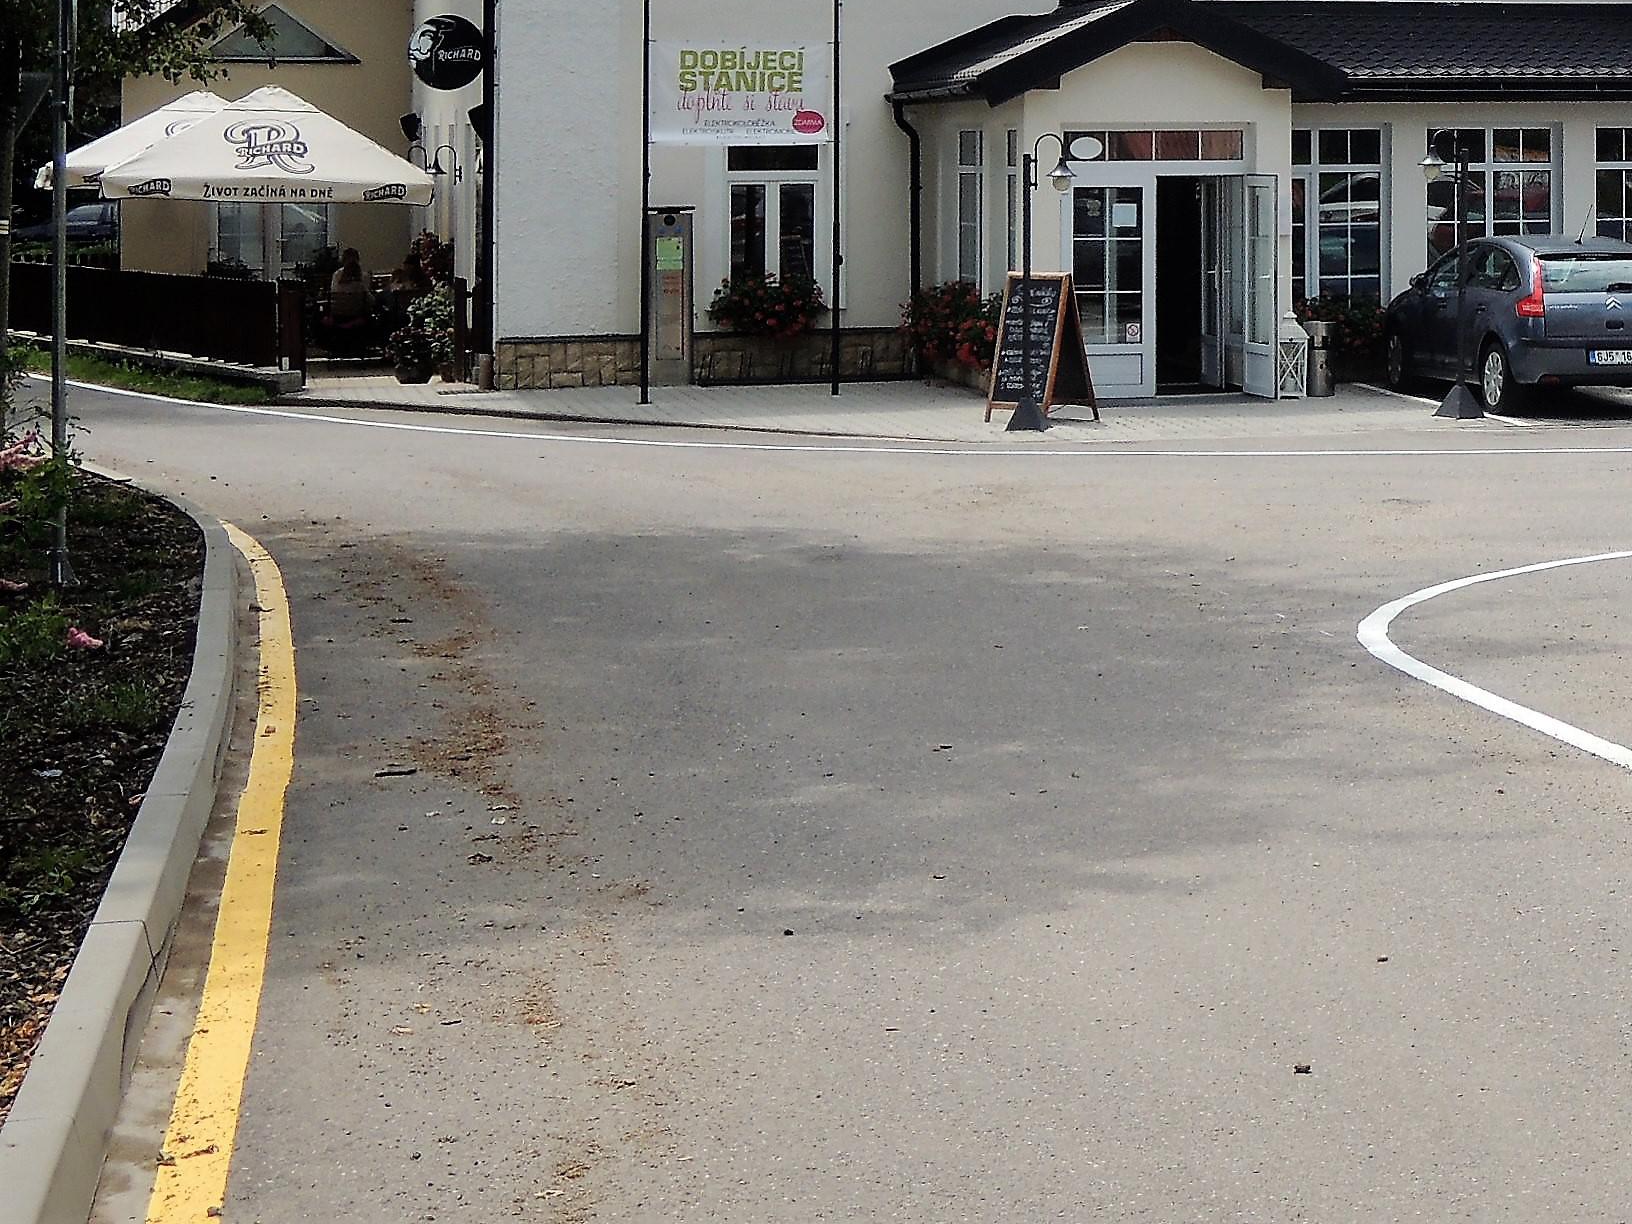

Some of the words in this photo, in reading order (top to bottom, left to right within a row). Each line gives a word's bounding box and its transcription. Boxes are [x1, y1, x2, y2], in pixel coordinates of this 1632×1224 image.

[438, 49, 481, 62] RICHARD
[679, 46, 805, 71] DOBÍJECÍ
[679, 71, 803, 92] STANICE
[237, 142, 306, 158] RICHARD
[129, 179, 171, 194] RICHARD
[203, 182, 239, 199] ŽIVOT
[243, 185, 286, 198] ZAČÍNÁ
[290, 188, 306, 198] NA
[311, 186, 333, 198] DNĚ
[364, 185, 406, 200] RICHARD
[1597, 351, 1615, 362] 6J5
